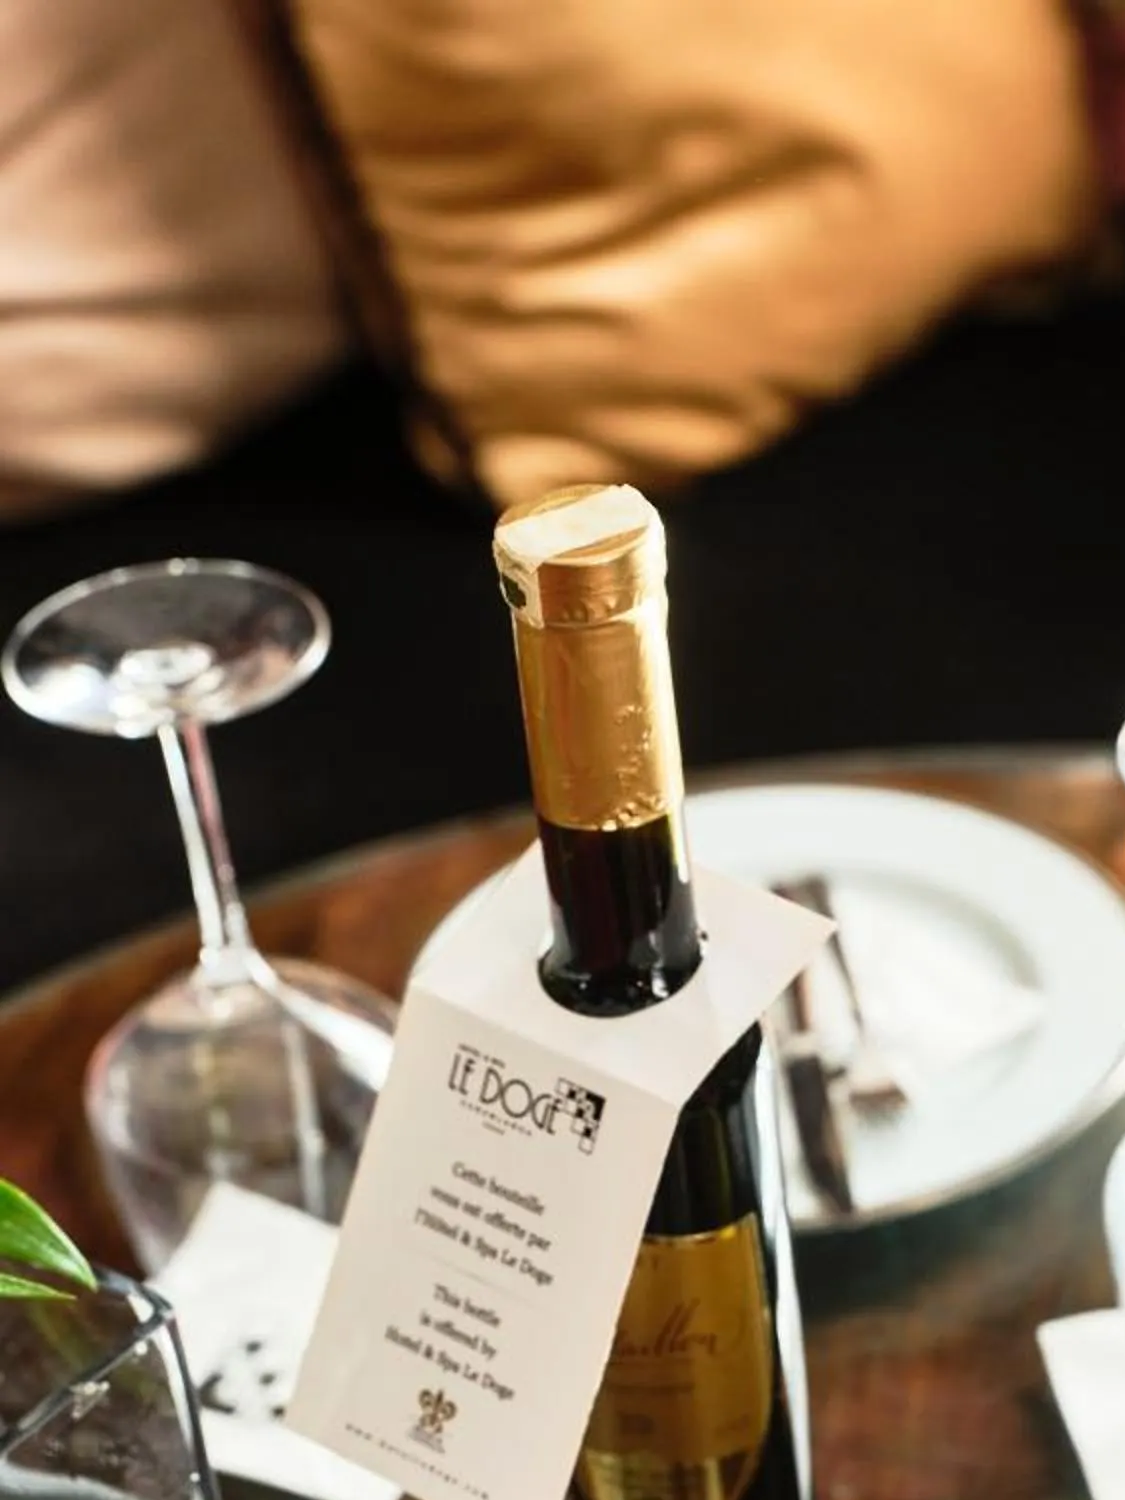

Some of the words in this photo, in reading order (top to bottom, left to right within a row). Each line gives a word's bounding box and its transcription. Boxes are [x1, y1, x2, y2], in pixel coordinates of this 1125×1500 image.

[448, 1052, 475, 1096] LE
[479, 1066, 562, 1136] DOGE
[430, 1184, 460, 1209] vous
[461, 1201, 483, 1218] est
[484, 1211, 527, 1240] offerte
[527, 1232, 552, 1252] par
[488, 1176, 546, 1217] bouteille
[460, 1229, 471, 1247] &
[475, 1236, 499, 1260] Spa
[500, 1248, 518, 1268] Le
[518, 1256, 554, 1287] Doge
[420, 1308, 431, 1327] is
[433, 1319, 479, 1351] offered
[480, 1338, 497, 1361] by
[432, 1282, 461, 1310] This
[463, 1296, 502, 1329] bottle
[424, 1343, 433, 1361] &
[436, 1350, 461, 1374] Spa
[462, 1362, 479, 1382] Le
[480, 1371, 516, 1401] Doge
